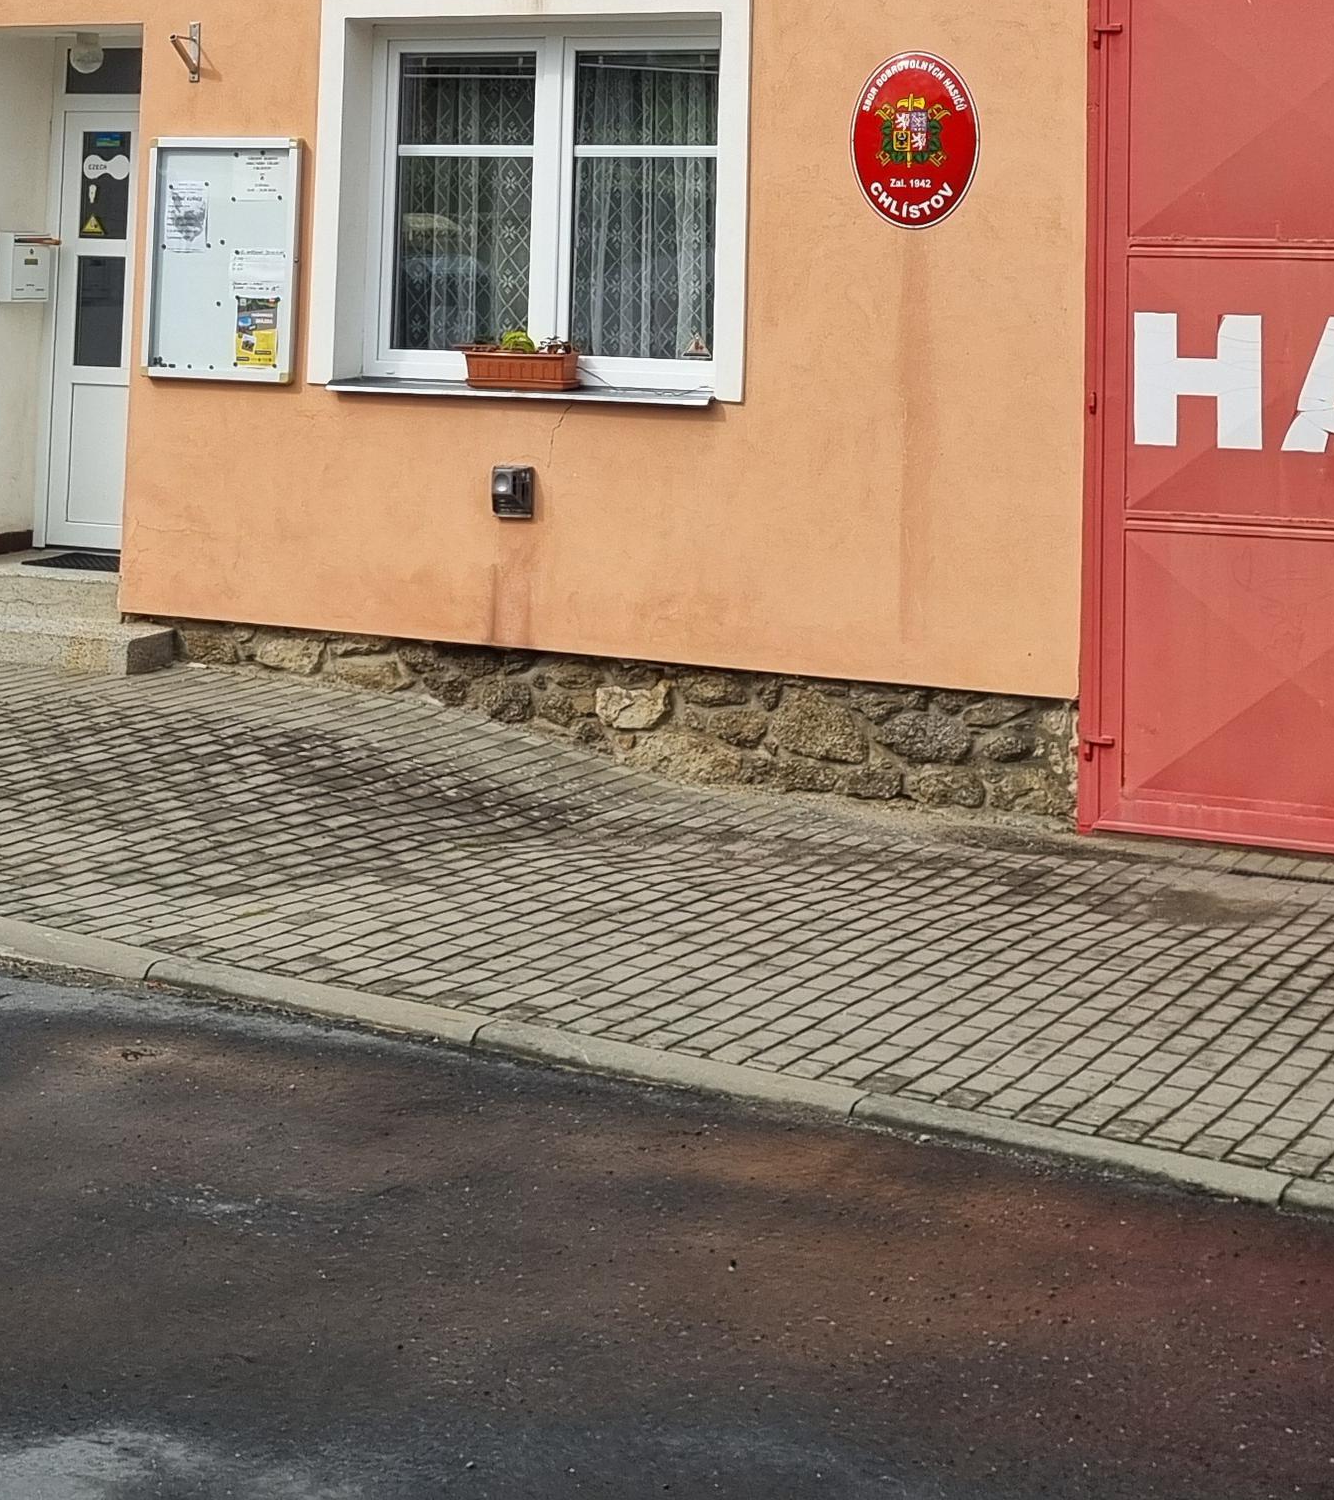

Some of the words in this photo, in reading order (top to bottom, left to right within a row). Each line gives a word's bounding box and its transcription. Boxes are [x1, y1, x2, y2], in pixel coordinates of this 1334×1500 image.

[876, 60, 945, 87] DOBROVOLNÝCH
[889, 178, 907, 188] Zal.
[909, 178, 932, 188] 1942
[870, 181, 954, 219] CHLÍSTOV
